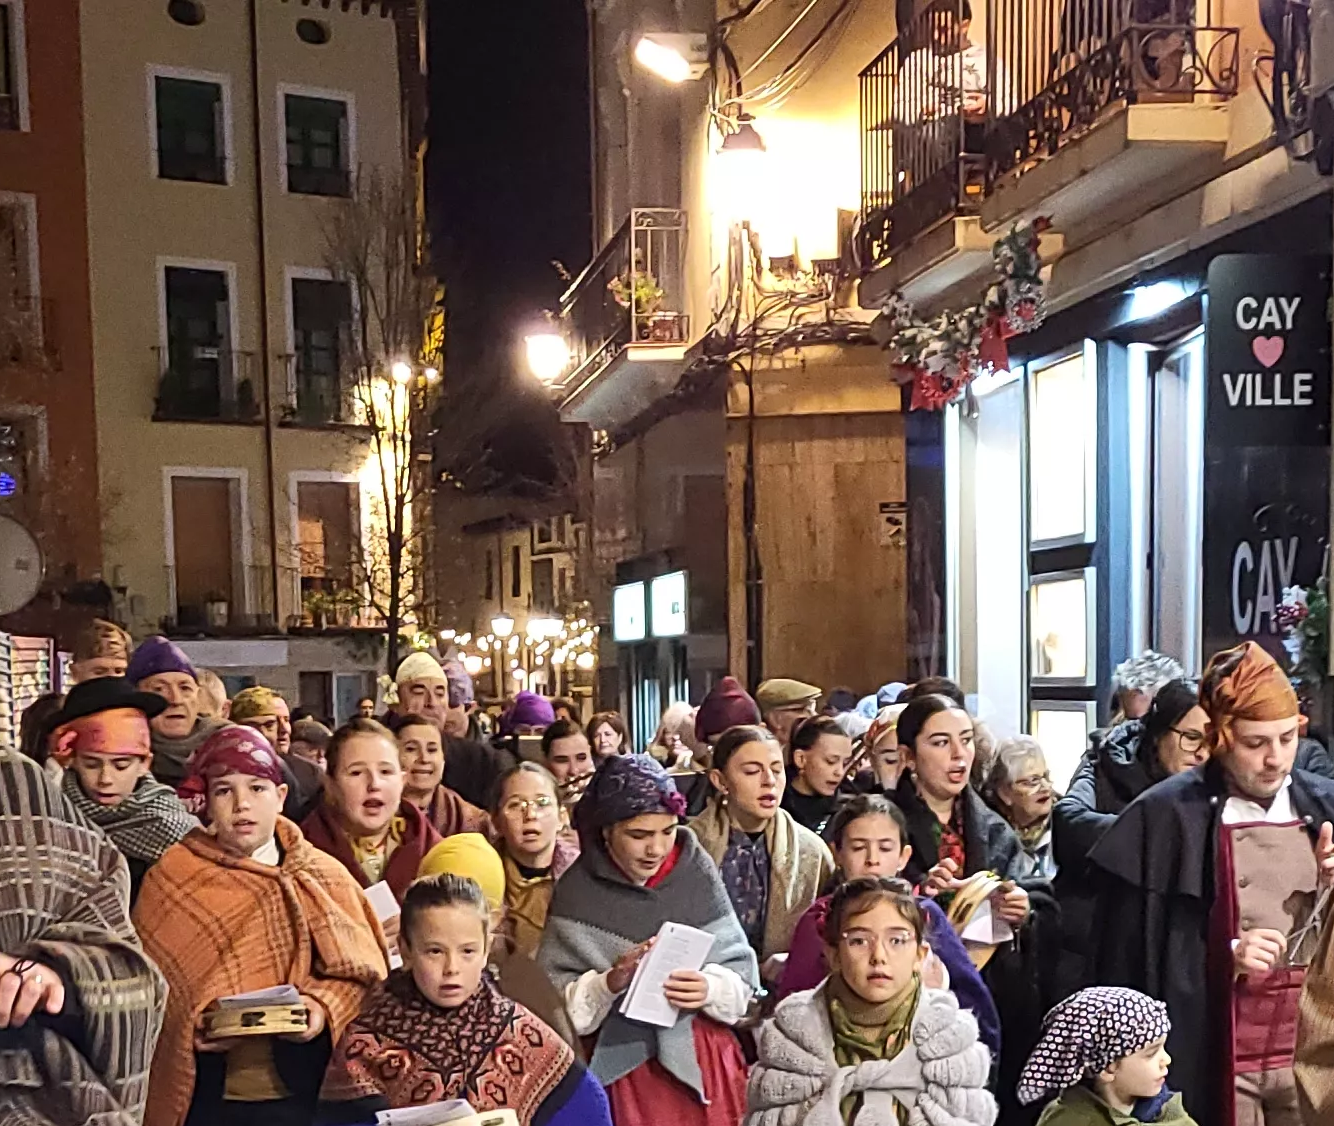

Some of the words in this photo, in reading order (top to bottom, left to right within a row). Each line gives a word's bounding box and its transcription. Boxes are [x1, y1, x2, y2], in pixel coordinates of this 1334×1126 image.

[1235, 296, 1302, 331] CAY
[1222, 372, 1314, 407] VILLE
[1232, 536, 1299, 635] CAY
